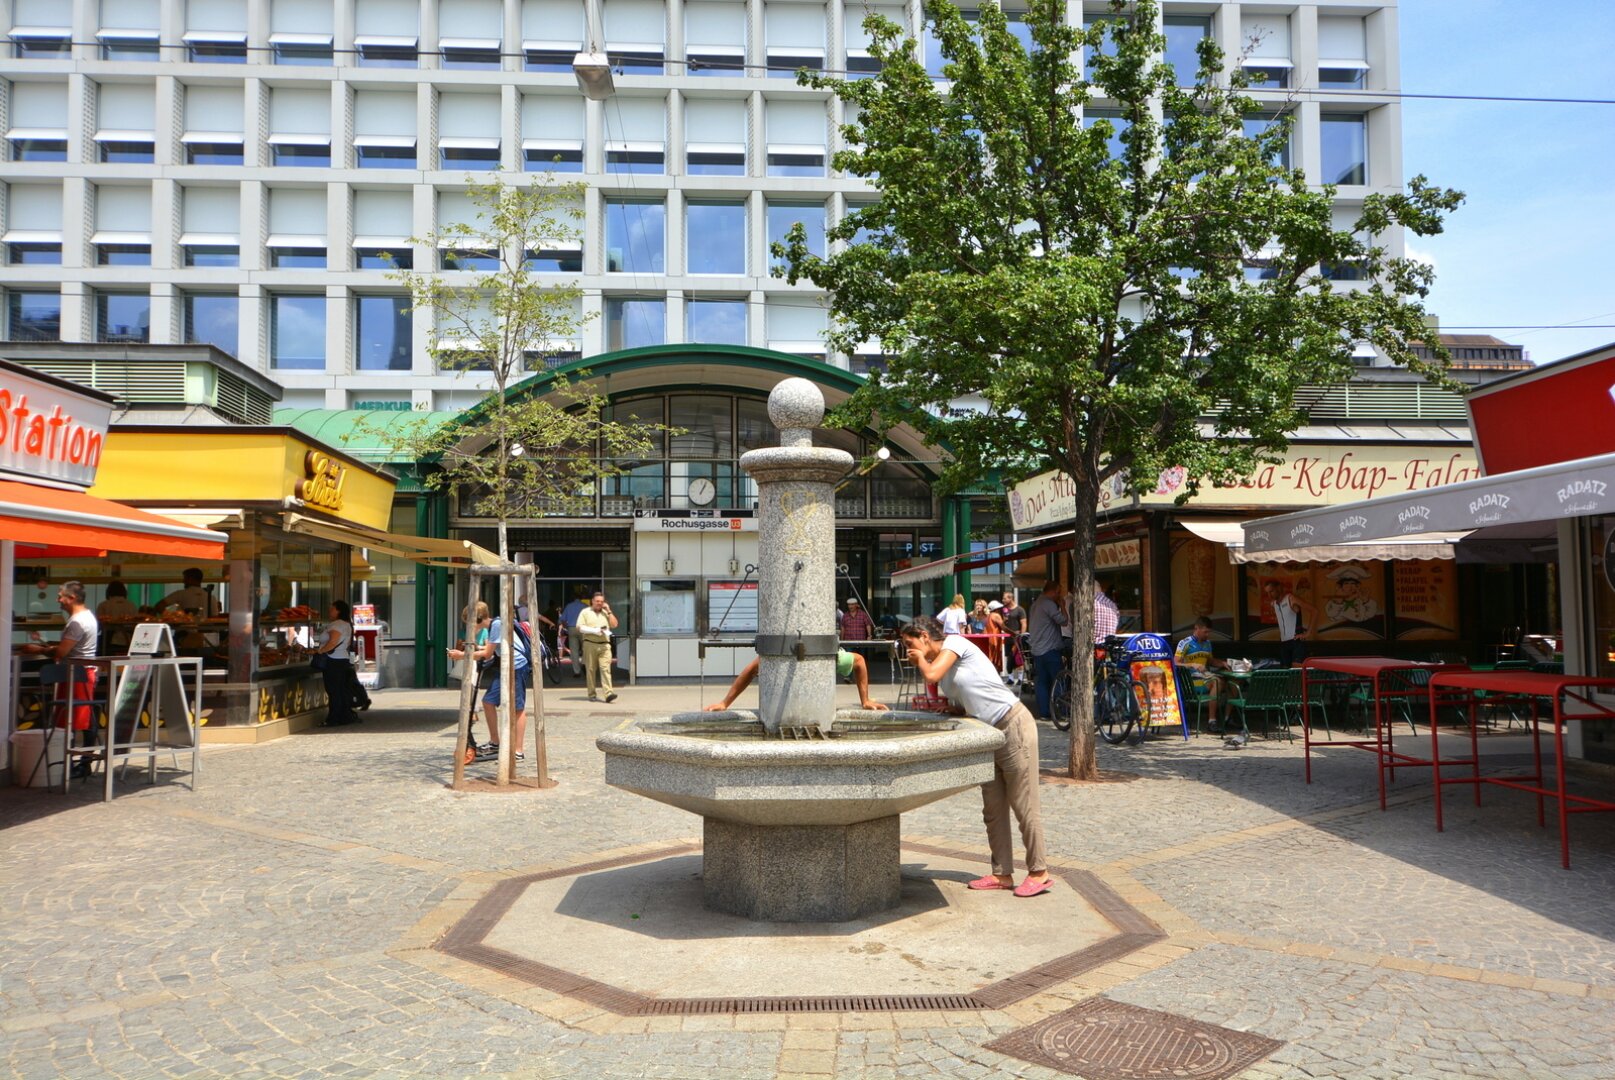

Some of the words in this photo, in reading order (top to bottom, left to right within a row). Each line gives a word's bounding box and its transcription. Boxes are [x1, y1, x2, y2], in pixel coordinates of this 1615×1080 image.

[354, 401, 412, 411] MERKUR
[1557, 479, 1608, 503] RADATZ
[1469, 493, 1511, 515] RADATZ
[1398, 505, 1431, 525] RADATZ
[661, 519, 730, 530] Rochusgasse
[731, 520, 741, 528] U3
[1290, 524, 1315, 540] RADATZ
[1339, 515, 1368, 533] RADATZ
[906, 543, 935, 552] PST
[1136, 638, 1161, 650] NEU
